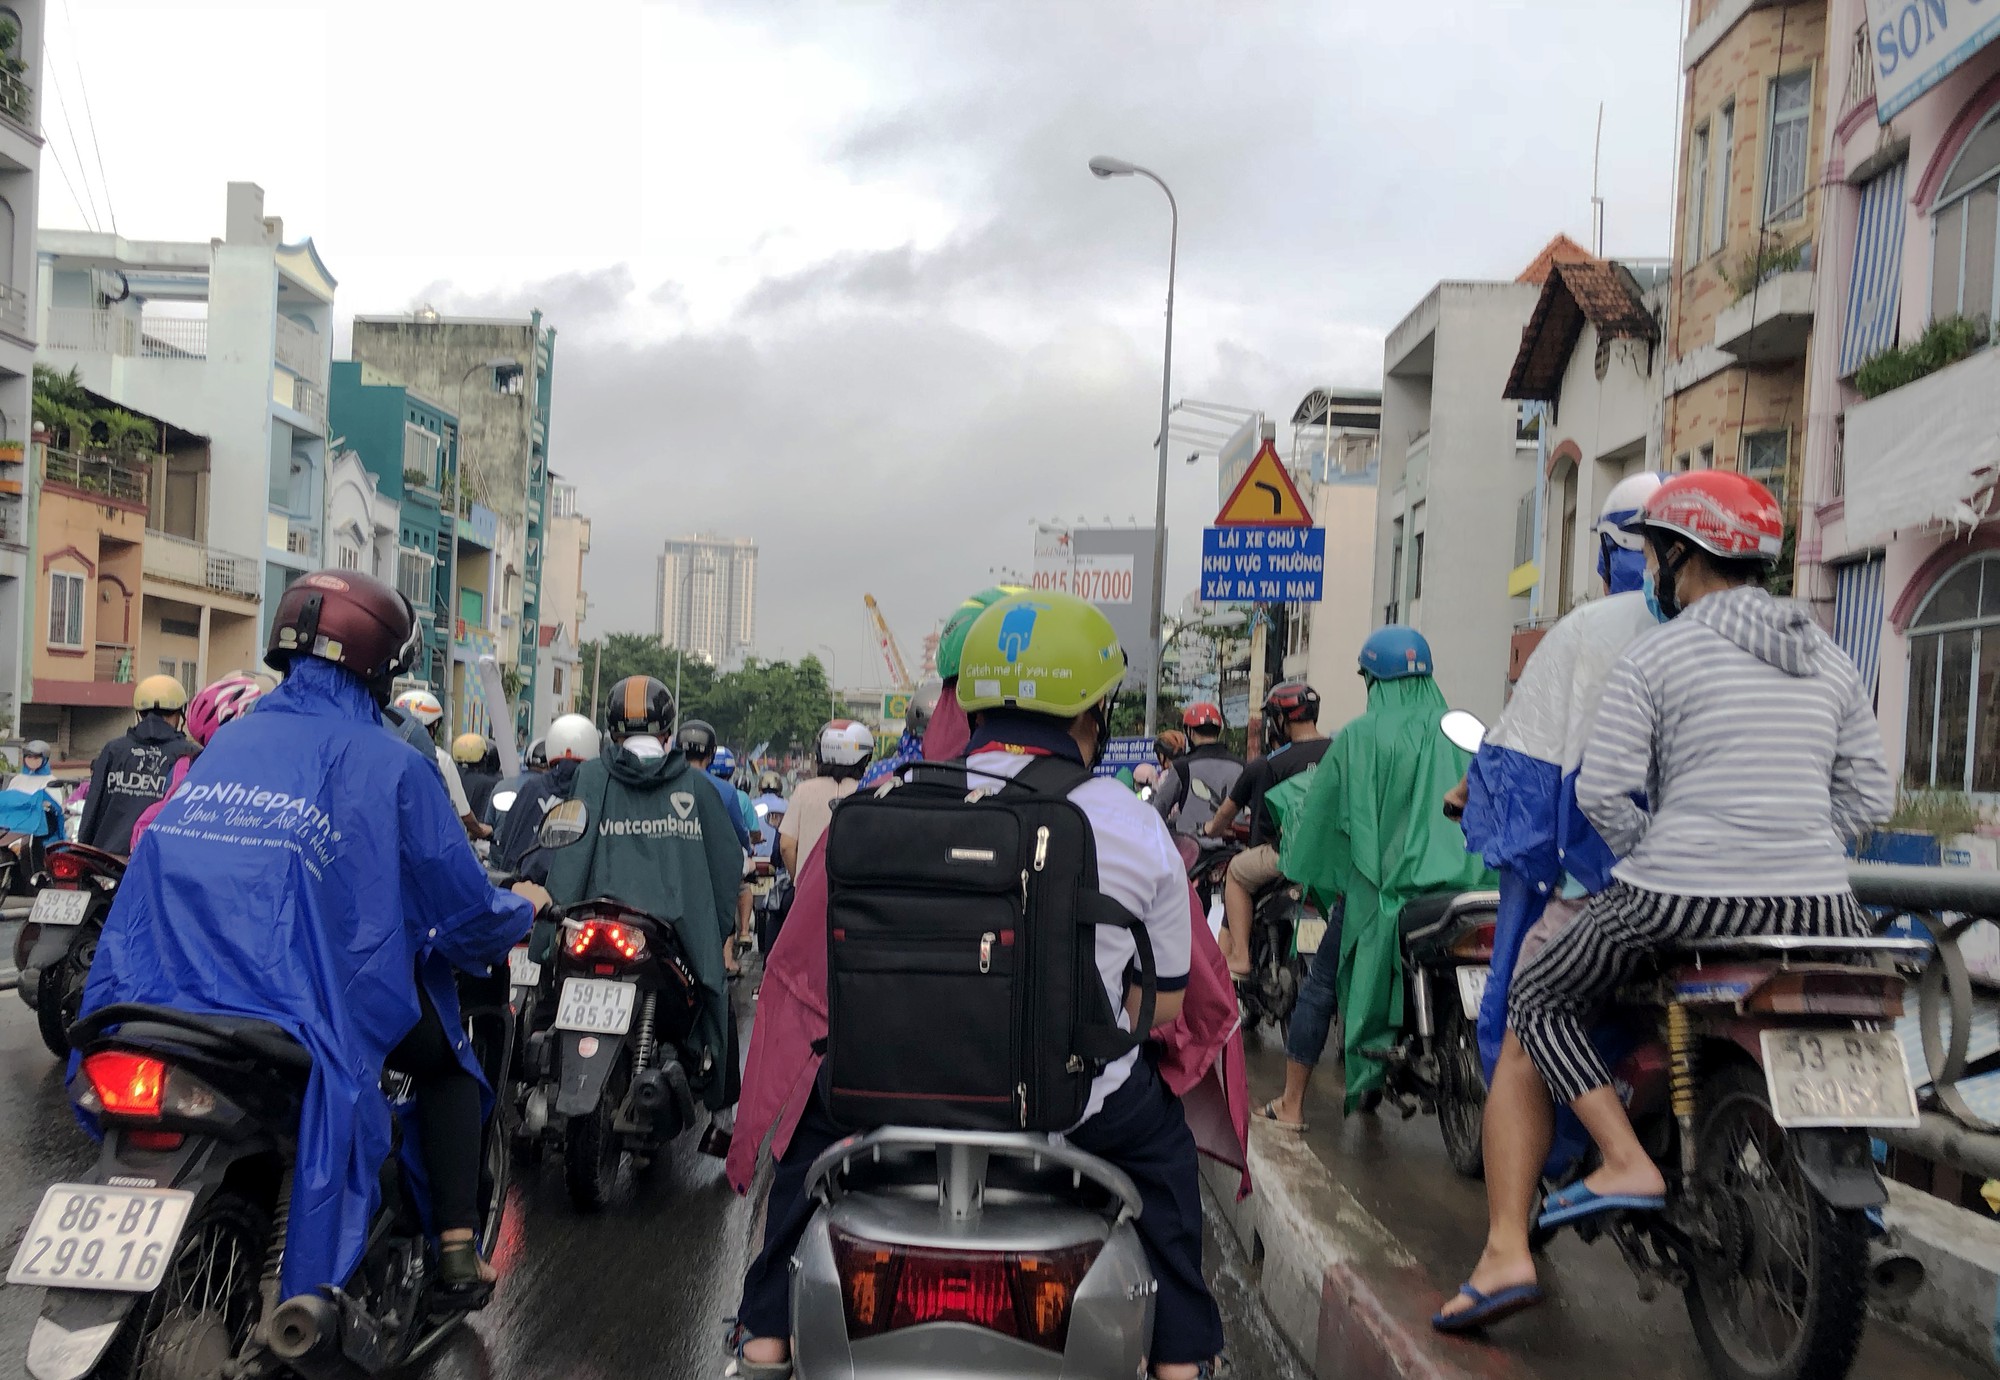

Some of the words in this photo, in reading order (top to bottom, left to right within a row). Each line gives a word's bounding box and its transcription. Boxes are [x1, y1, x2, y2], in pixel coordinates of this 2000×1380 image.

[1218, 527, 1240, 549] LÁI
[1267, 526, 1295, 549] CHÚ
[1300, 527, 1309, 549] Ý
[1203, 554, 1231, 573] KHU
[1235, 551, 1262, 577] VỰC
[1268, 550, 1322, 573] THƯỜNG
[1206, 574, 1232, 598] XẢY
[1237, 580, 1256, 598] RA
[1260, 580, 1281, 598] TAI
[993, 665, 1011, 677] me
[1026, 665, 1048, 678] you
[1052, 668, 1073, 680] can
[178, 803, 219, 825] Your
[224, 806, 264, 828] Vision
[599, 813, 703, 837] Vietcombank
[240, 836, 262, 847] QUAY
[572, 982, 623, 1007] 59-F1
[561, 1003, 627, 1031] 485.37
[108, 1176, 157, 1188] HONDA
[57, 1193, 166, 1237] 86-B1
[22, 1236, 163, 1281] 299.16
